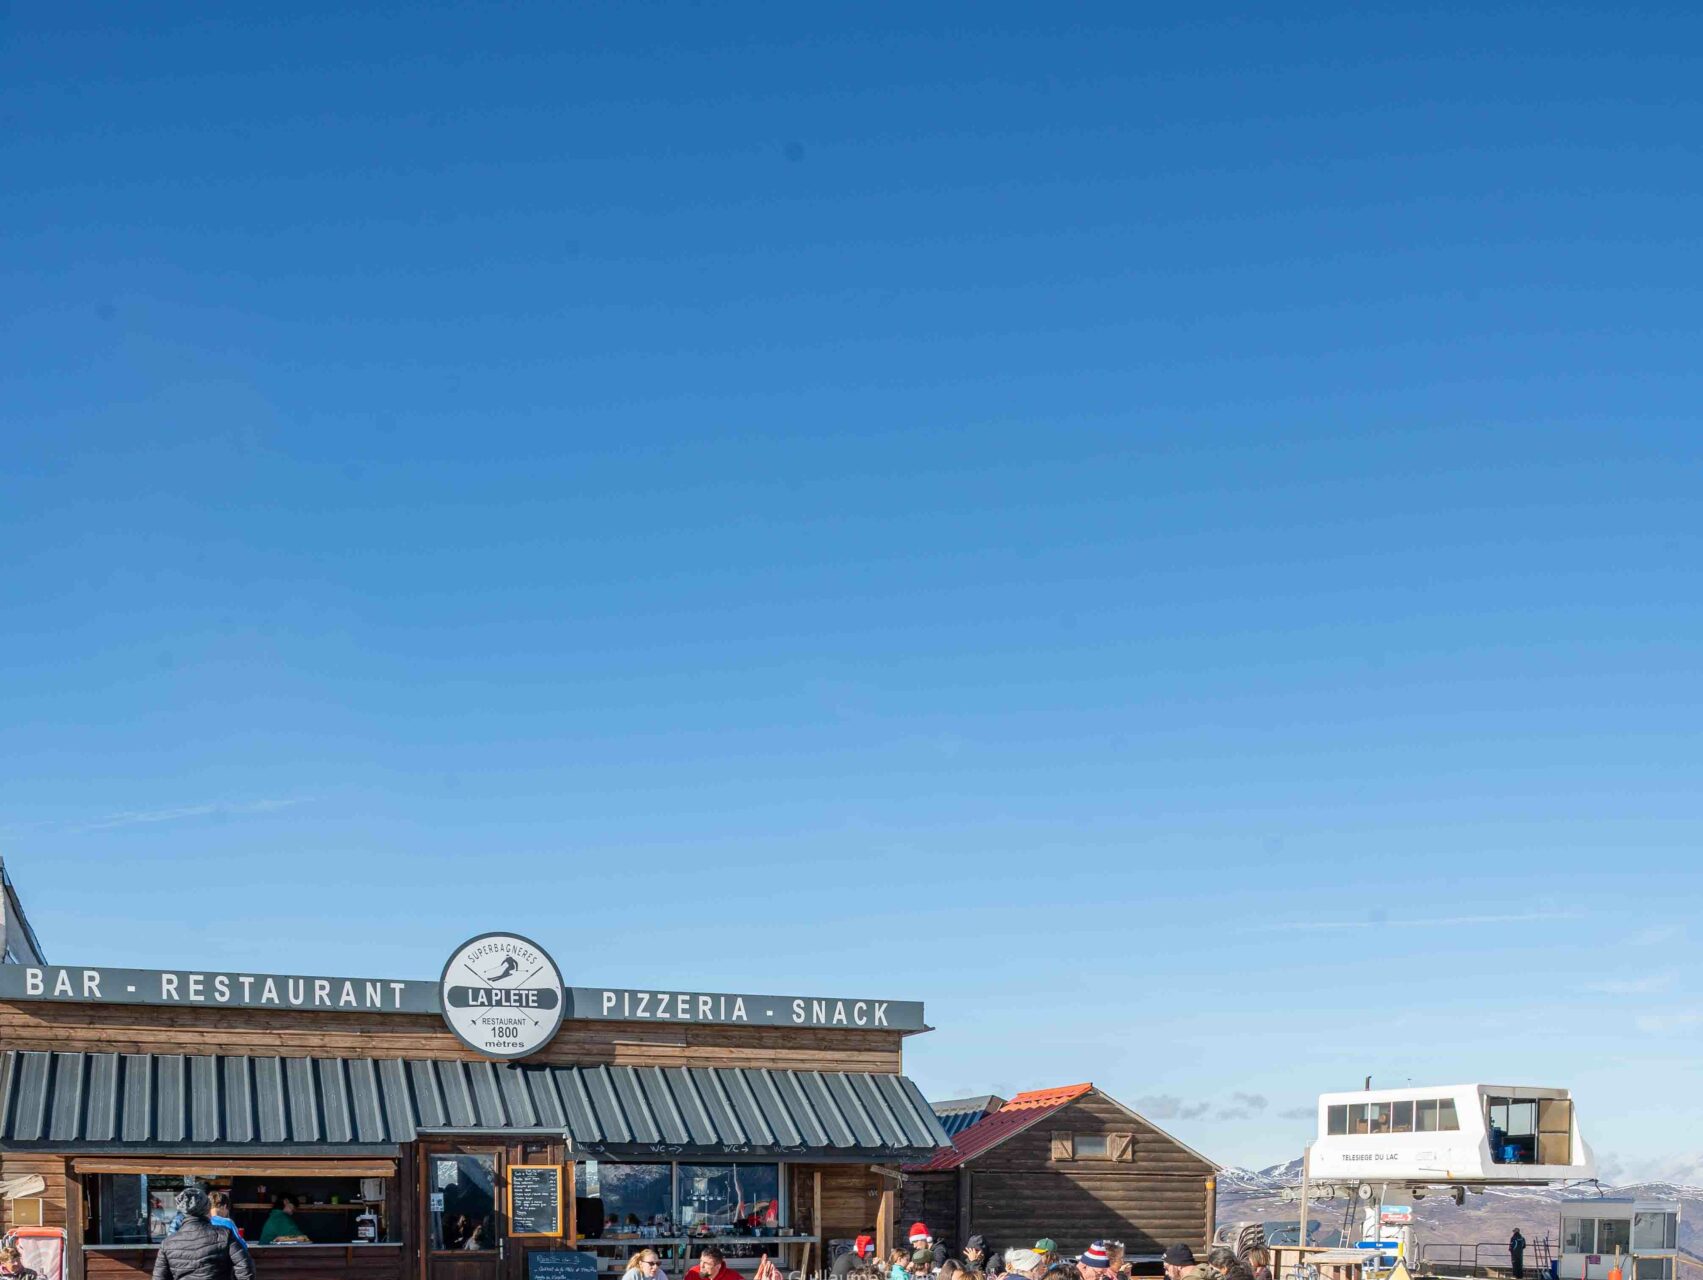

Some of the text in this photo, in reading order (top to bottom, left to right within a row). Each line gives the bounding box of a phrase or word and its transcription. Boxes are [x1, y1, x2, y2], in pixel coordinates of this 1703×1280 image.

[467, 943, 538, 965] SUPERBAGNERES
[25, 968, 102, 998] BAR
[161, 973, 406, 1009] RESTAURANT
[468, 988, 539, 1007] LA PLETE
[602, 991, 748, 1022] PIZZERIA
[792, 999, 889, 1026] SNACK
[481, 1017, 527, 1026] RESTAURANT
[491, 1026, 519, 1038] 1800
[485, 1040, 525, 1048] mètres
[650, 1145, 666, 1153] WC
[722, 1145, 739, 1153] WC
[773, 1145, 789, 1153] WC
[1386, 1153, 1399, 1161] LAC
